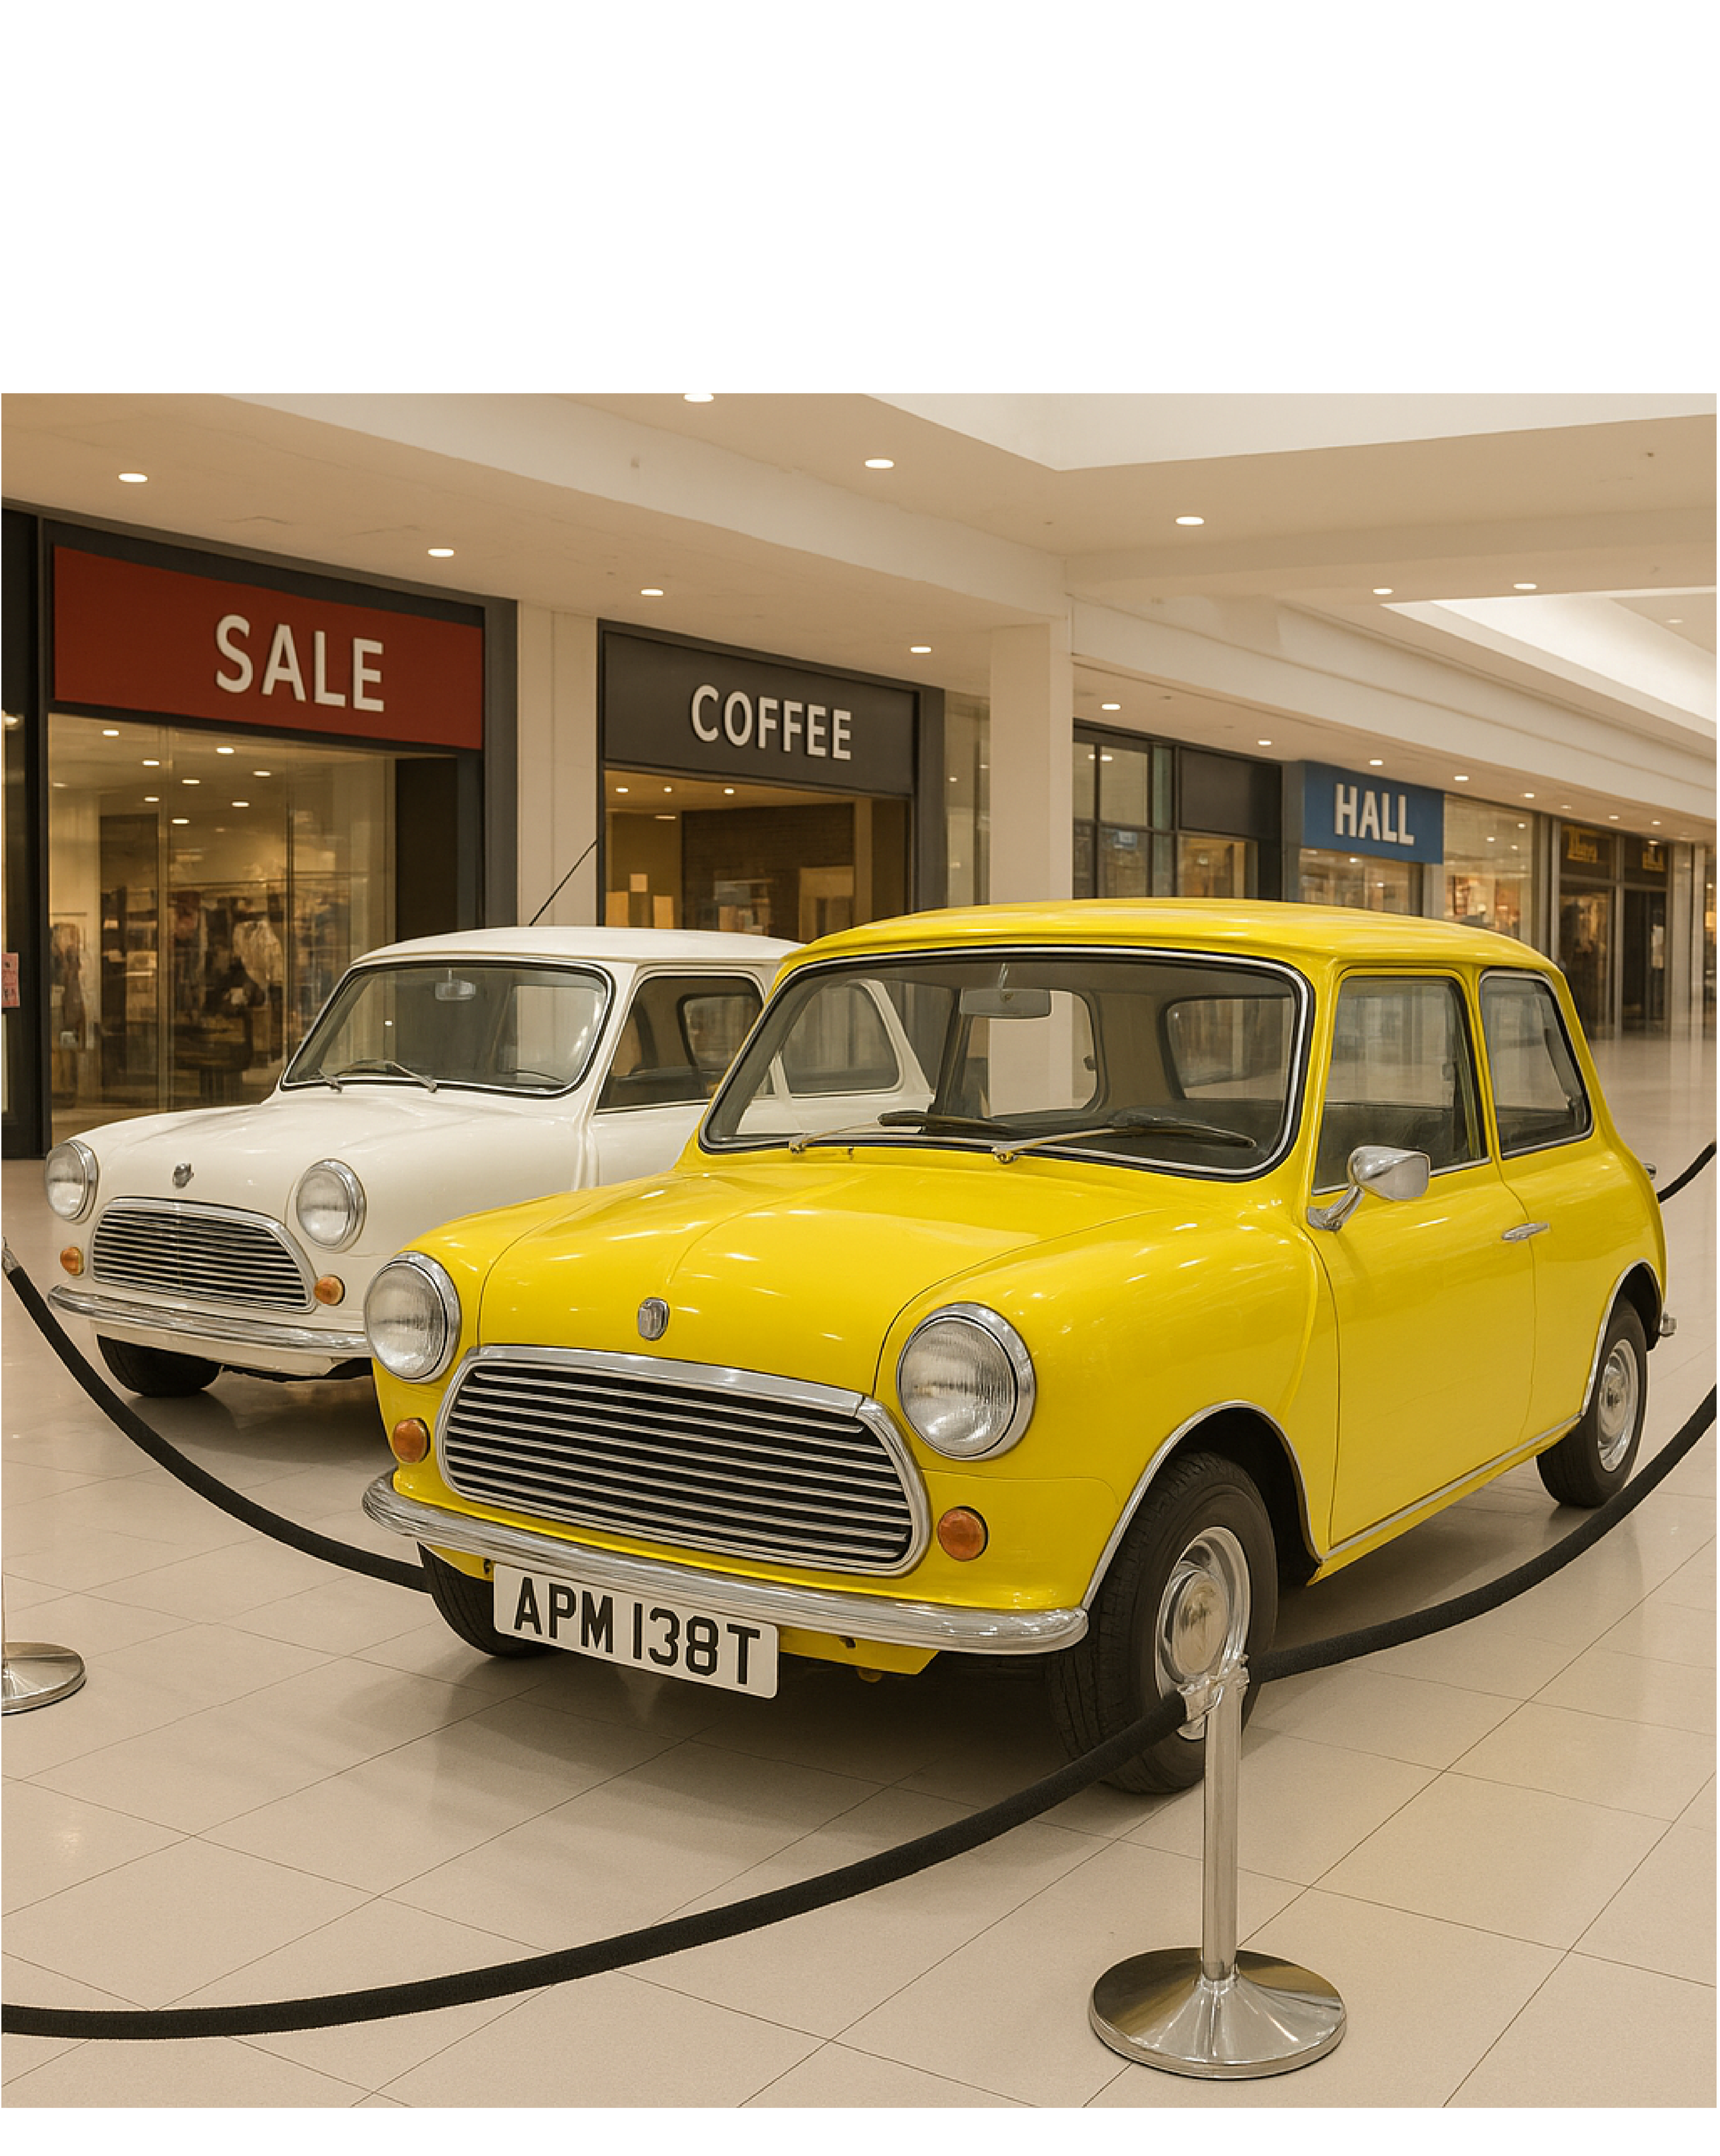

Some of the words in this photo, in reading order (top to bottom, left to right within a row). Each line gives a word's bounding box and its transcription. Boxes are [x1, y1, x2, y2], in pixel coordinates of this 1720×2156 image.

[215, 614, 385, 712] SALE
[690, 684, 852, 761] COFFEE
[1334, 782, 1415, 846] HALL
[513, 1576, 614, 1654] APM
[631, 1602, 761, 1686] 138T
